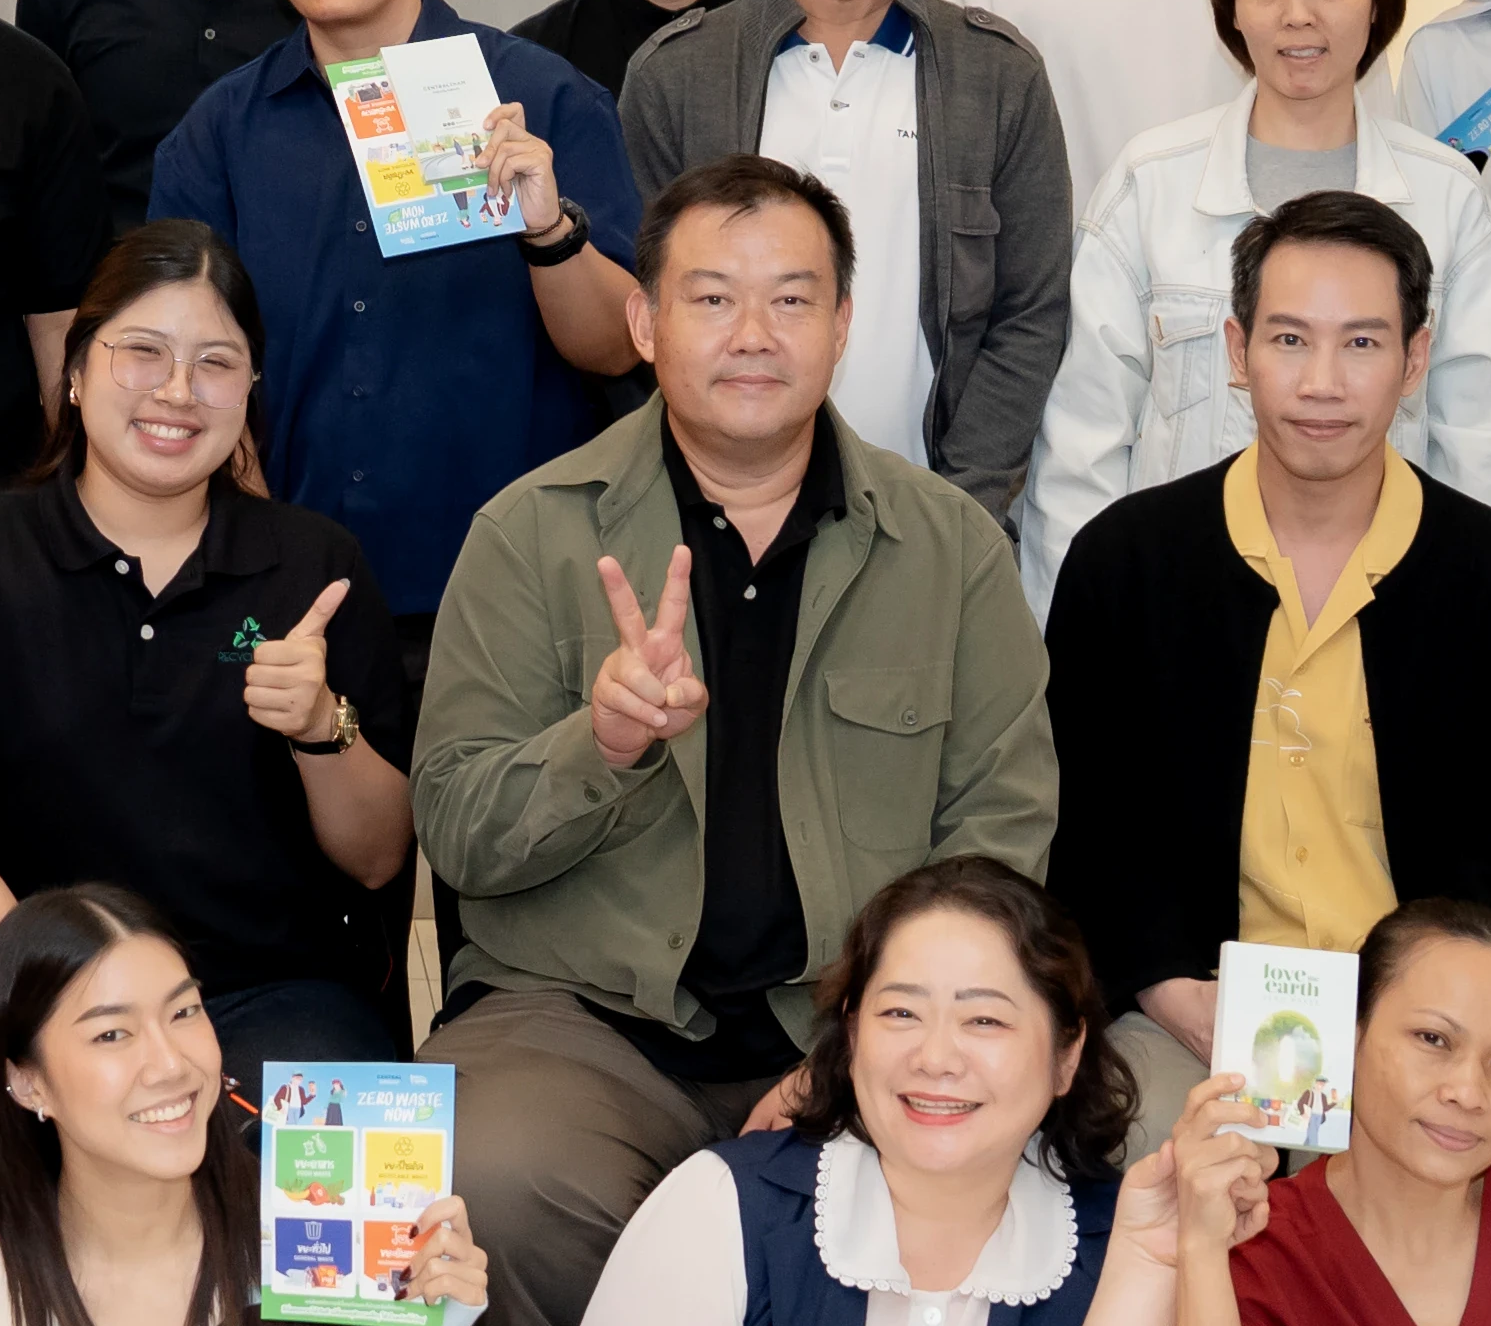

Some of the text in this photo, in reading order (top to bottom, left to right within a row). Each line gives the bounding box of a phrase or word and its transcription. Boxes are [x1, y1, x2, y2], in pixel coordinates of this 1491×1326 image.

[1263, 962, 1307, 980] love
[1264, 979, 1320, 997] earth
[356, 1091, 444, 1108] ZERO WASTE
[383, 1106, 416, 1123] NOW
